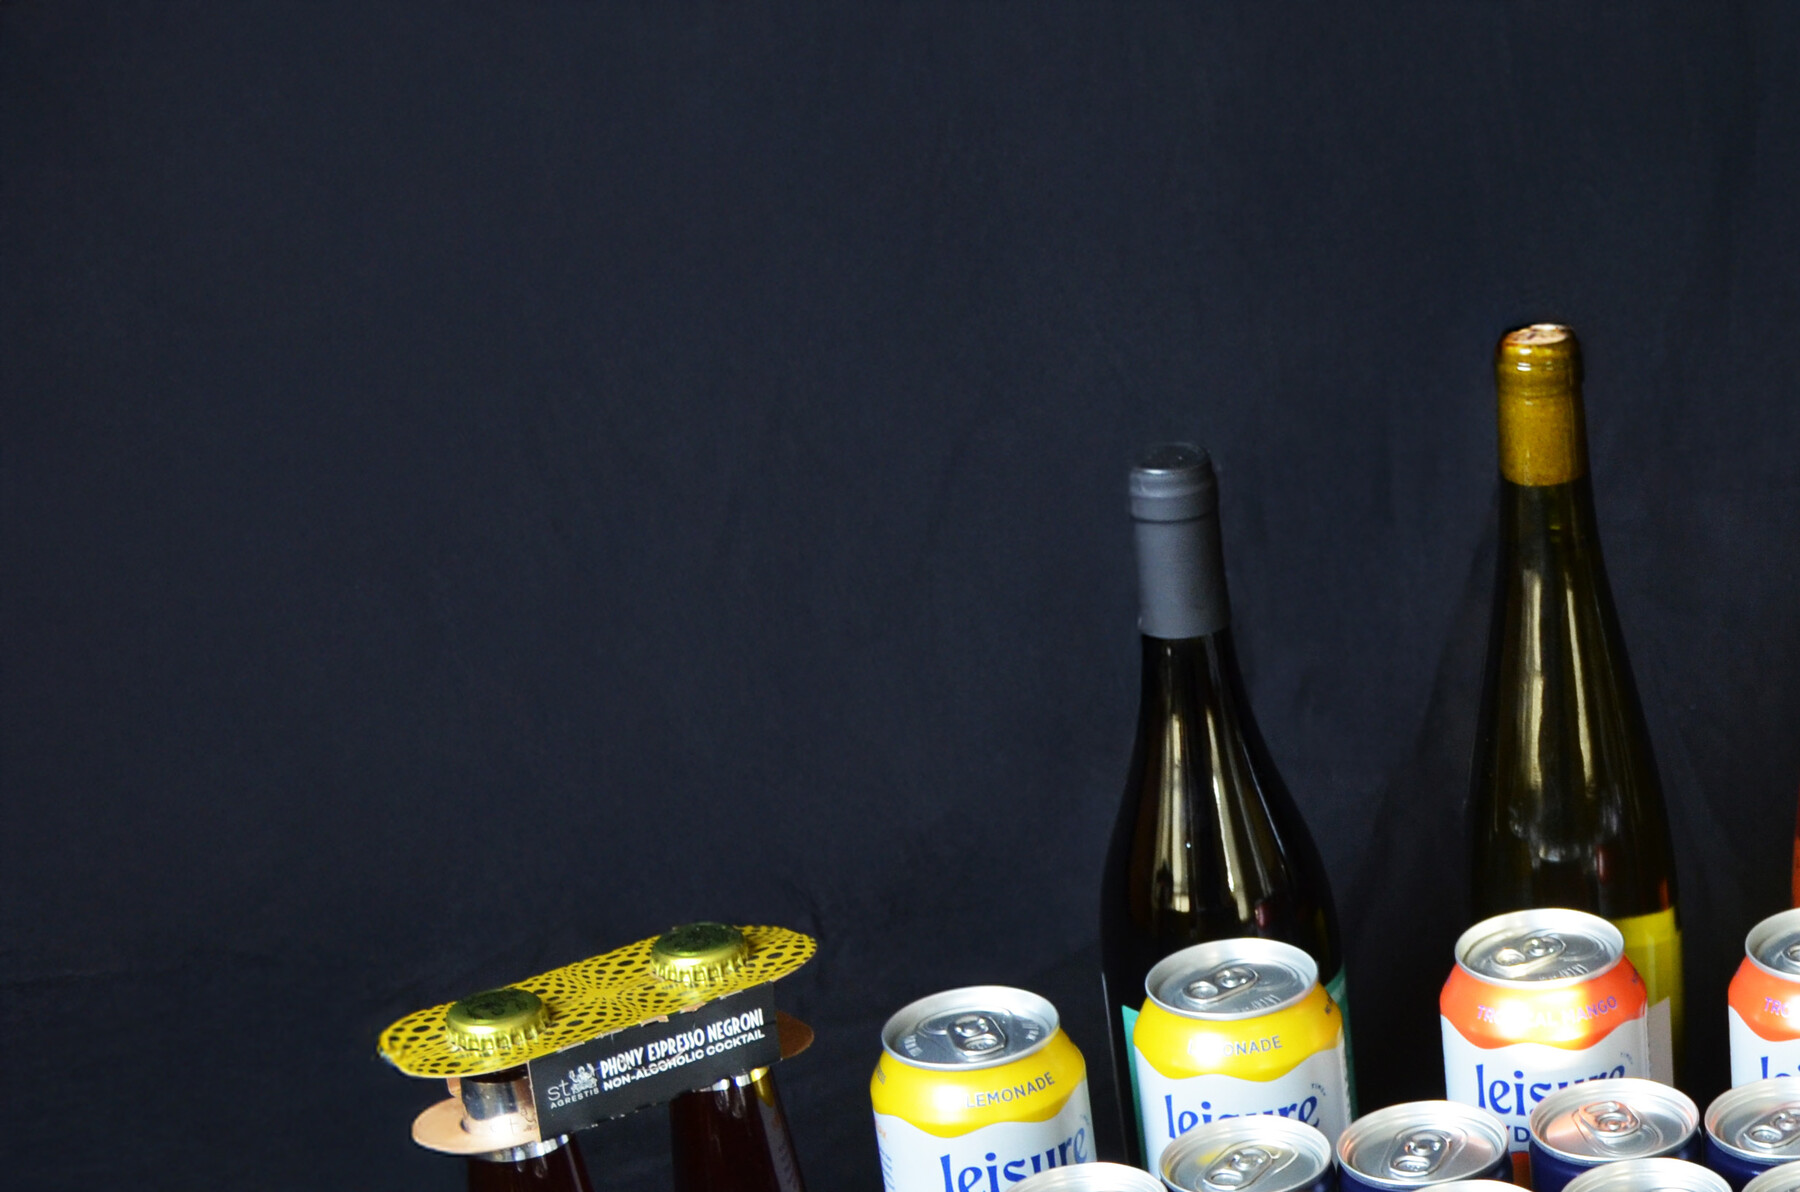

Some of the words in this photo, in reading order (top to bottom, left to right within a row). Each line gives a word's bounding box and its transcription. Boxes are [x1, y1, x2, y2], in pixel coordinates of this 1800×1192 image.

[1562, 995, 1618, 1024] MANGO
[600, 1046, 644, 1080] PHONY
[647, 1028, 706, 1061] ESPRESSO
[706, 1008, 765, 1043] NEGRONI
[603, 1048, 704, 1092] NON-ALCOHOLIC
[705, 1029, 765, 1056] COCKTAIL
[550, 1087, 599, 1110] AGRESTIS
[966, 1071, 1056, 1108] LEMONADE
